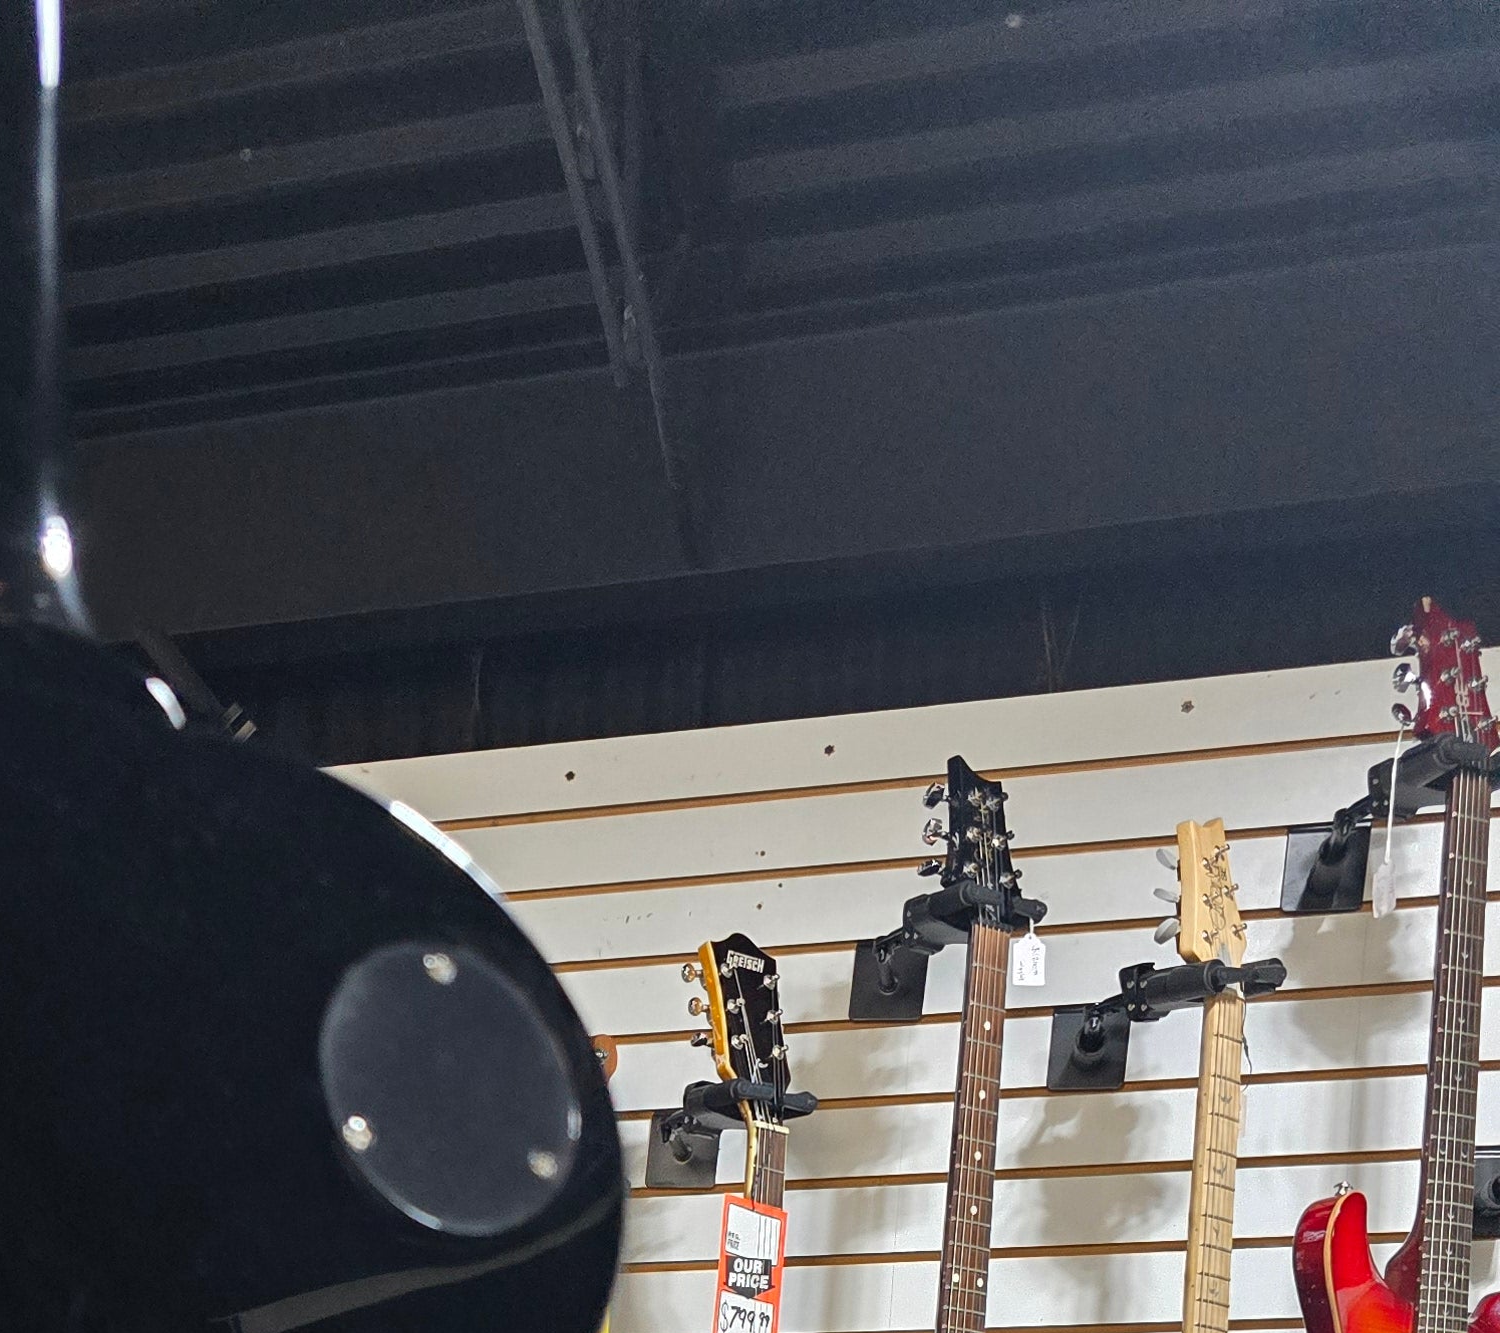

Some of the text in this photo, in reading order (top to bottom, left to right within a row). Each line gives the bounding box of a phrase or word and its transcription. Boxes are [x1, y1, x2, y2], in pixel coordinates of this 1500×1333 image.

[726, 950, 765, 973] GRETSCH
[733, 1257, 763, 1274] OUR
[727, 1271, 770, 1290] PRICE
